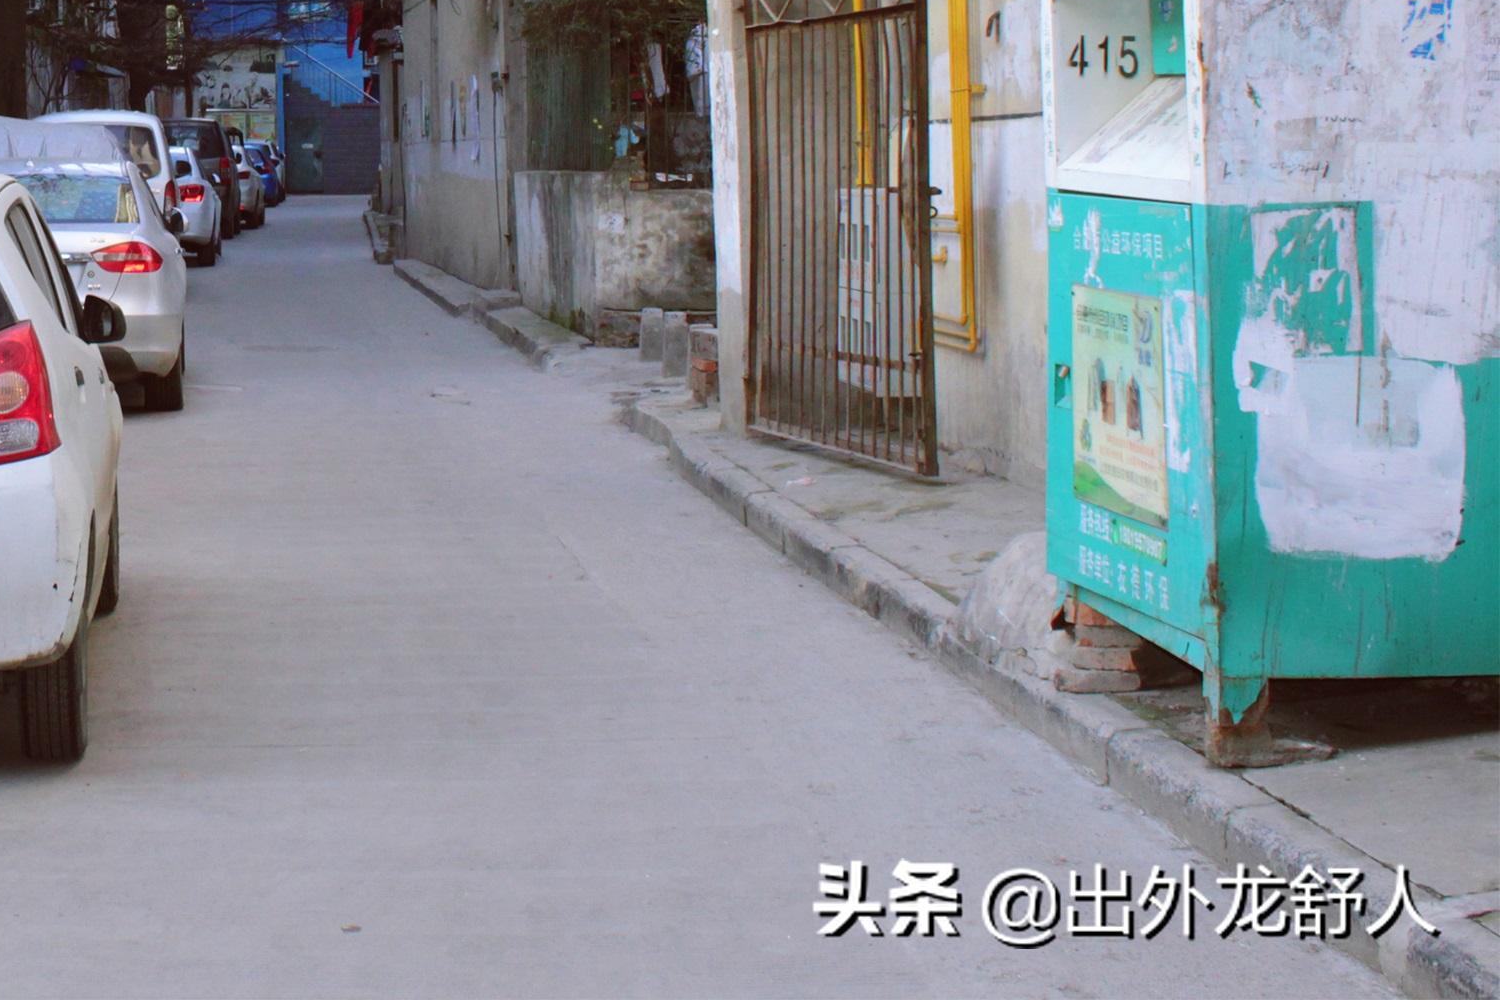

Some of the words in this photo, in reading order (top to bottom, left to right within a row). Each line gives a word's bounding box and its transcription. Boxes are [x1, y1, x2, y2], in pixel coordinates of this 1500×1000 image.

[1068, 34, 1139, 79] 415
[1073, 225, 1163, 261] 合公益环保项目
